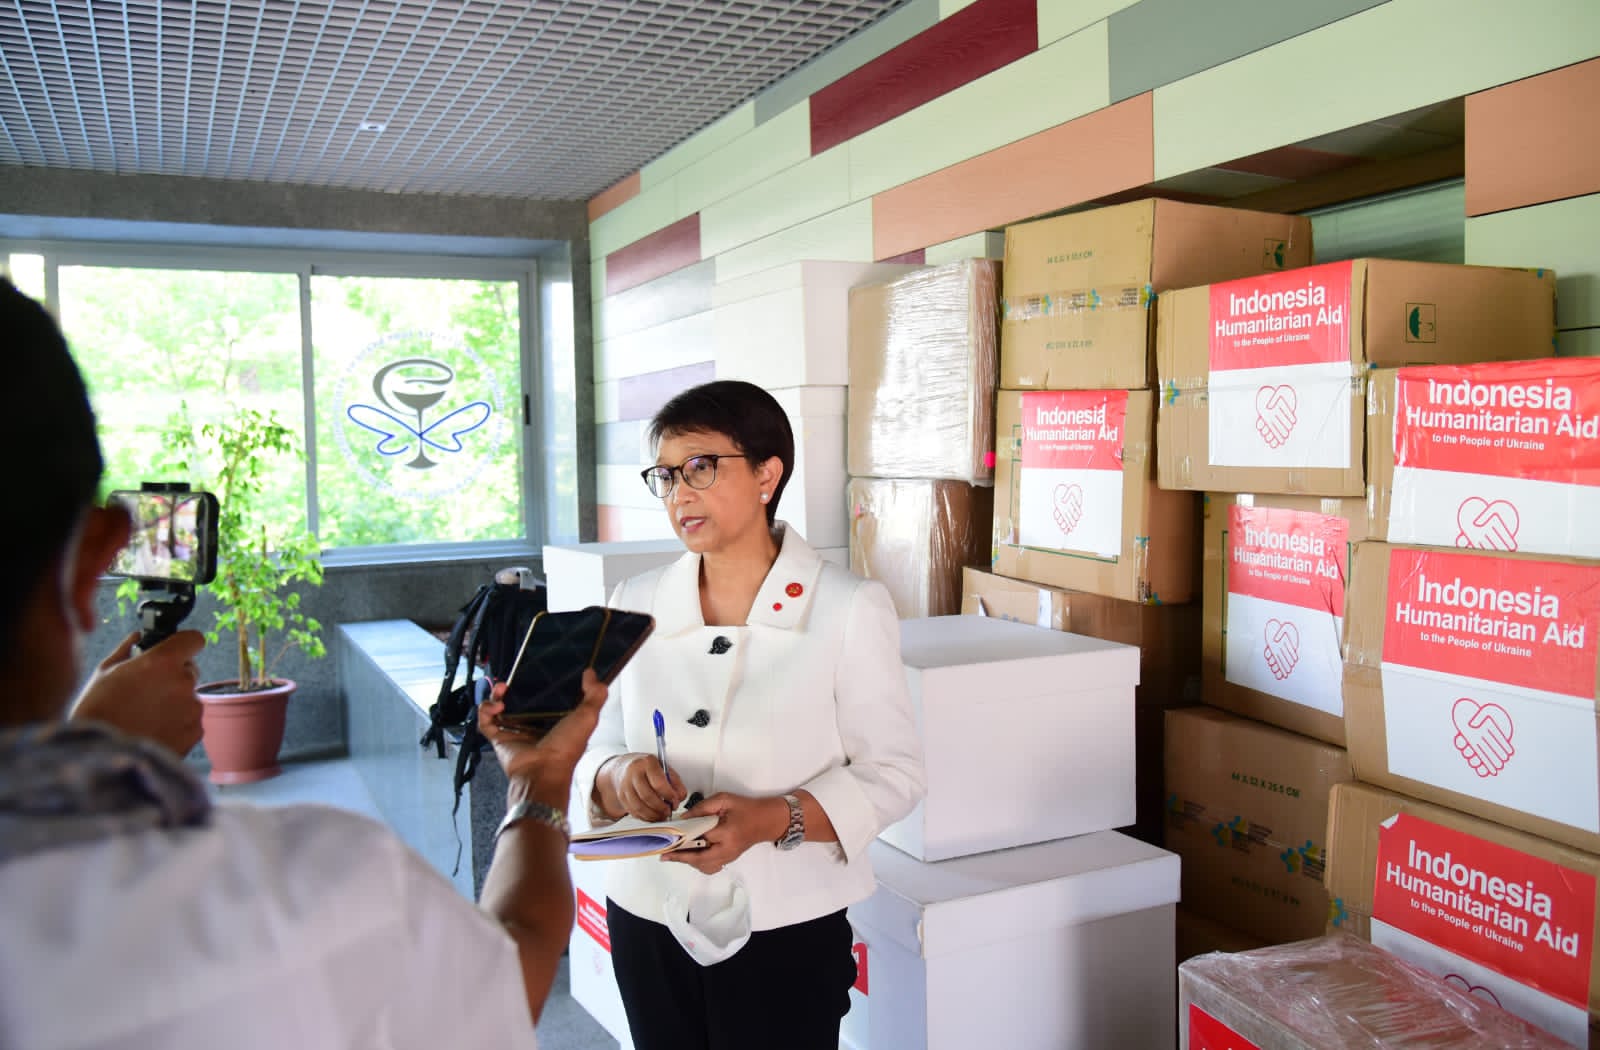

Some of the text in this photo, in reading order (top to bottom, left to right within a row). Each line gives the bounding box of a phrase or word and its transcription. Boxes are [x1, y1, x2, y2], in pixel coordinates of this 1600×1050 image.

[1230, 281, 1325, 316] Indonesia
[1215, 304, 1342, 337] Humanitarian Aid
[1429, 379, 1572, 411] Indonesia
[1037, 405, 1106, 425] Indonesia
[1406, 406, 1599, 439] Humanitarian Aid
[1026, 424, 1118, 442] Humanitarian Aid
[1432, 433, 1545, 451] to the People of Ukraine
[1245, 523, 1325, 557] Indonesia
[1233, 546, 1339, 580] Humanitarian Aid
[1417, 574, 1559, 619] Indonesia
[1395, 602, 1585, 649] Humanitarian Aid
[1420, 631, 1532, 657] to the People of Ukraine
[1408, 839, 1552, 920] Indonesia
[1386, 862, 1529, 937] Humanitarian
[1534, 920, 1579, 957] Aid
[1411, 898, 1524, 952] to the People of Ukraine
